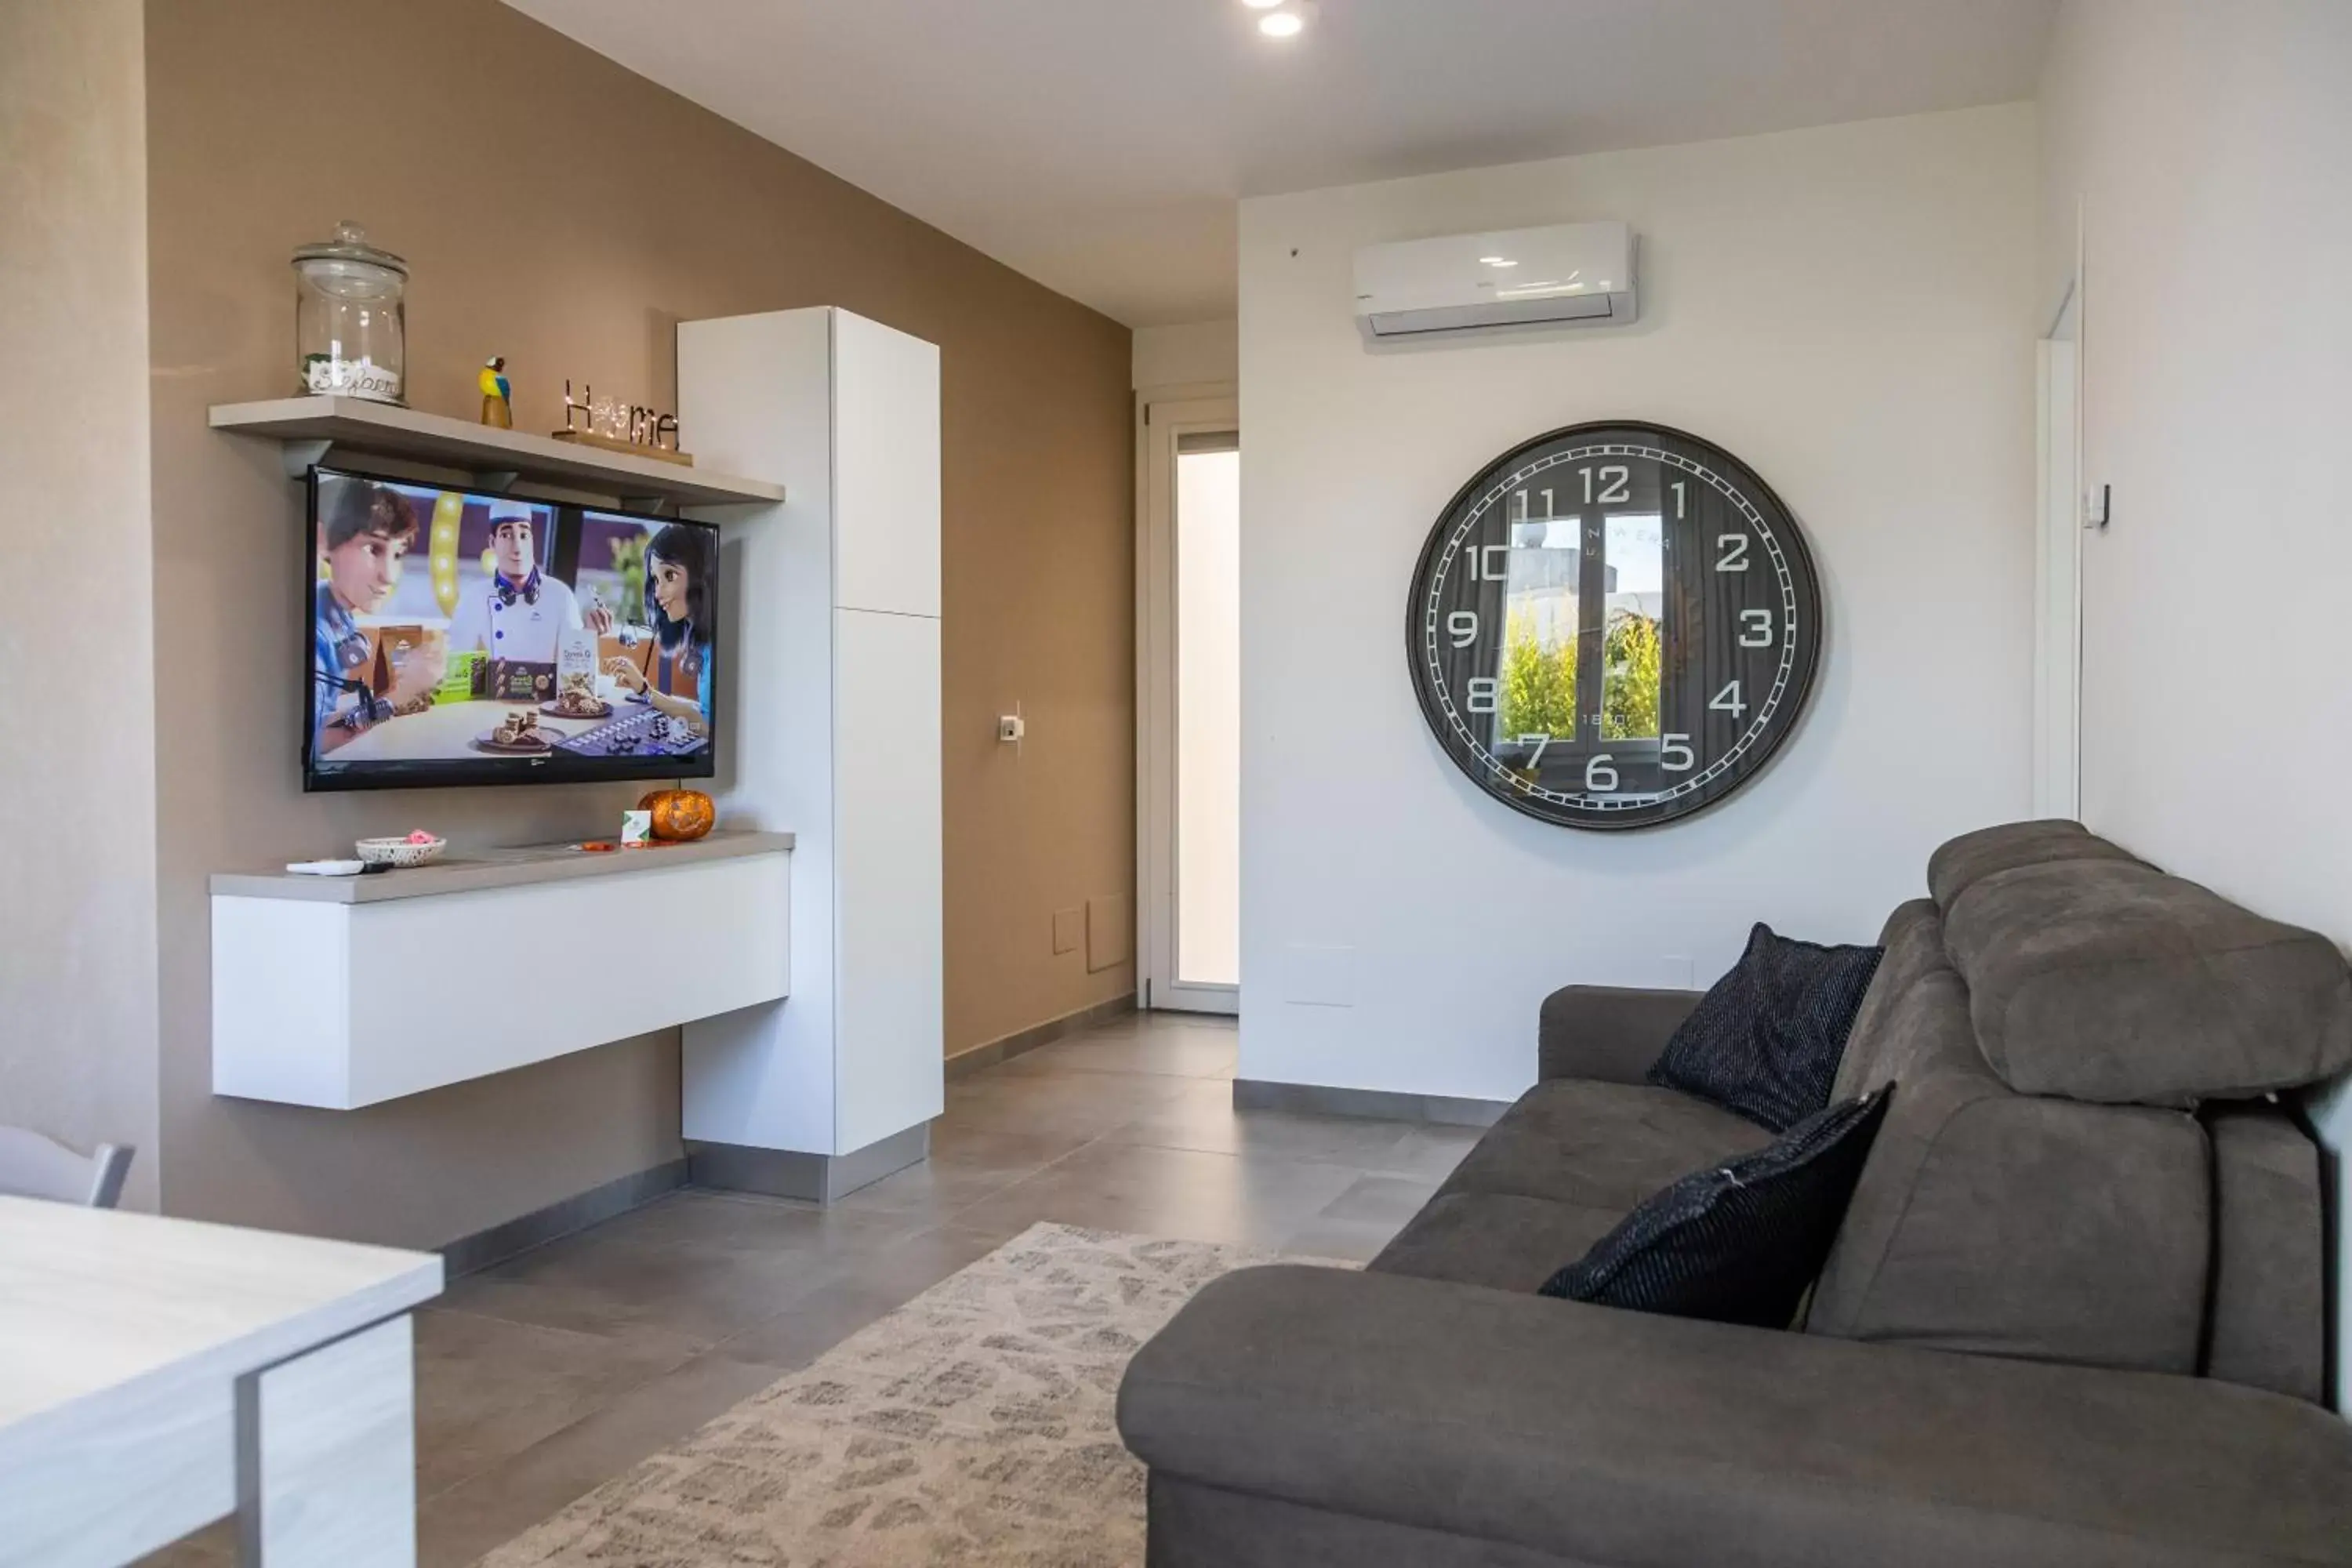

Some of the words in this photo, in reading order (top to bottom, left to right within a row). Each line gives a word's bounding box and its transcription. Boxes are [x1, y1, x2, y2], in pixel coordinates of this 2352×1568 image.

[1578, 466, 1630, 503] 12
[1671, 481, 1686, 518] 1
[1515, 489, 1554, 521] 11
[1588, 526, 1627, 539] NW
[1466, 544, 1512, 581] 10
[1715, 533, 1749, 571] 2
[1448, 611, 1479, 648] 9
[1740, 609, 1773, 647] 3
[1468, 677, 1498, 713] 8
[1708, 681, 1747, 718] 4
[1582, 714, 1624, 725] 180
[1518, 733, 1549, 771] 7
[1661, 734, 1694, 771] 5
[1585, 754, 1619, 791] 6
